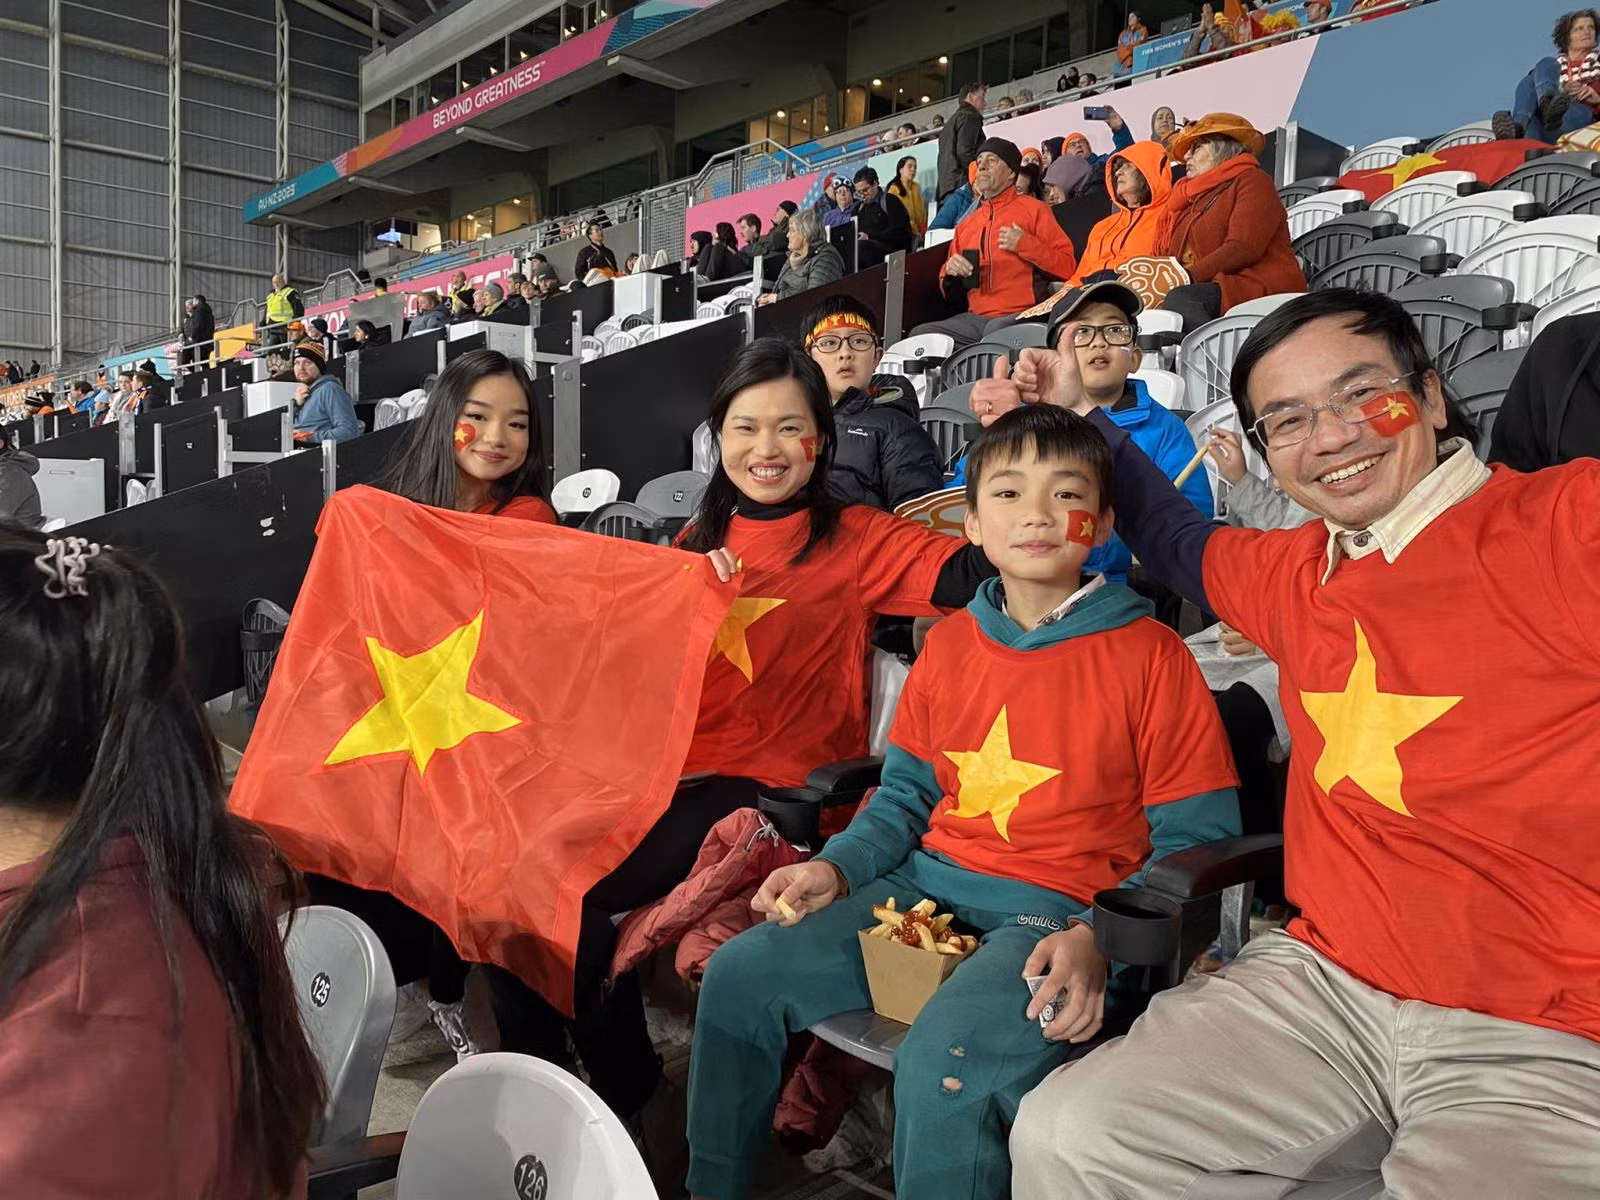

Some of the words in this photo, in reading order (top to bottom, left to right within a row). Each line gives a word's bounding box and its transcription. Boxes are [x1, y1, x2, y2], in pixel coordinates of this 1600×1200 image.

[1141, 48, 1154, 56] FIFA
[1155, 40, 1182, 52] WOMEN'S
[433, 97, 473, 129] BEYOND
[673, 492, 684, 501] 122
[312, 976, 330, 1004] 125
[518, 1162, 545, 1200] 126
